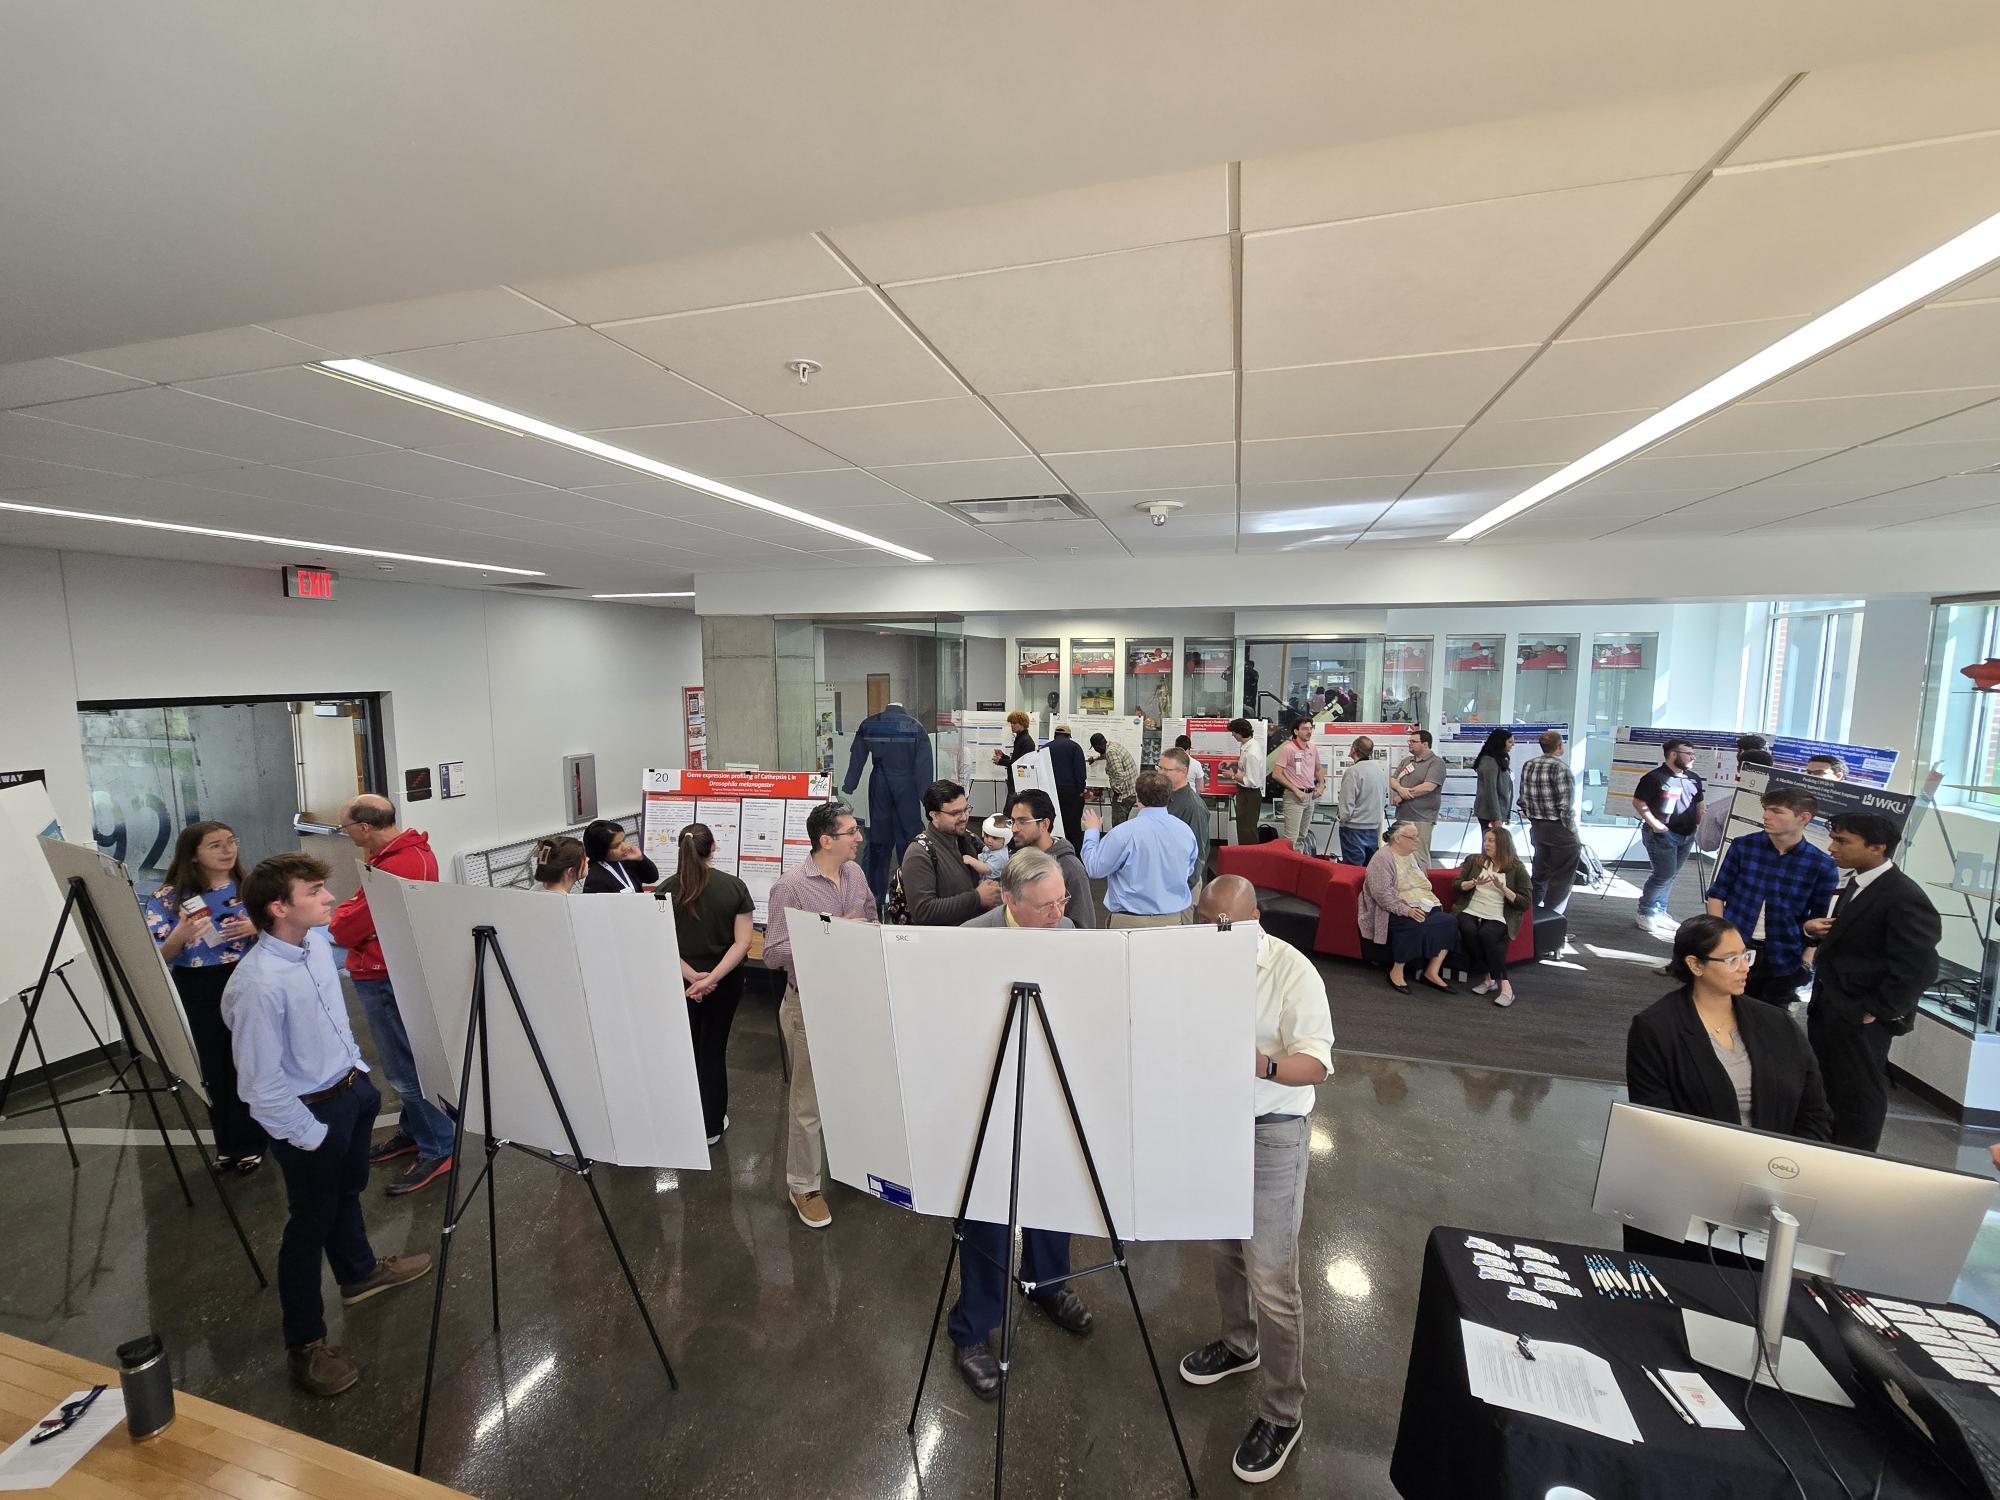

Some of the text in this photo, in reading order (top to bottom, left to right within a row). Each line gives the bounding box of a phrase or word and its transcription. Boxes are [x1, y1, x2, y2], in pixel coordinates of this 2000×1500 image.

[298, 570, 331, 598] EXIT
[0, 774, 24, 783] WAY
[655, 772, 669, 783] 20
[709, 780, 738, 788] Drosophila
[1875, 797, 1907, 814] WKU
[1772, 1163, 1796, 1173] DELL
